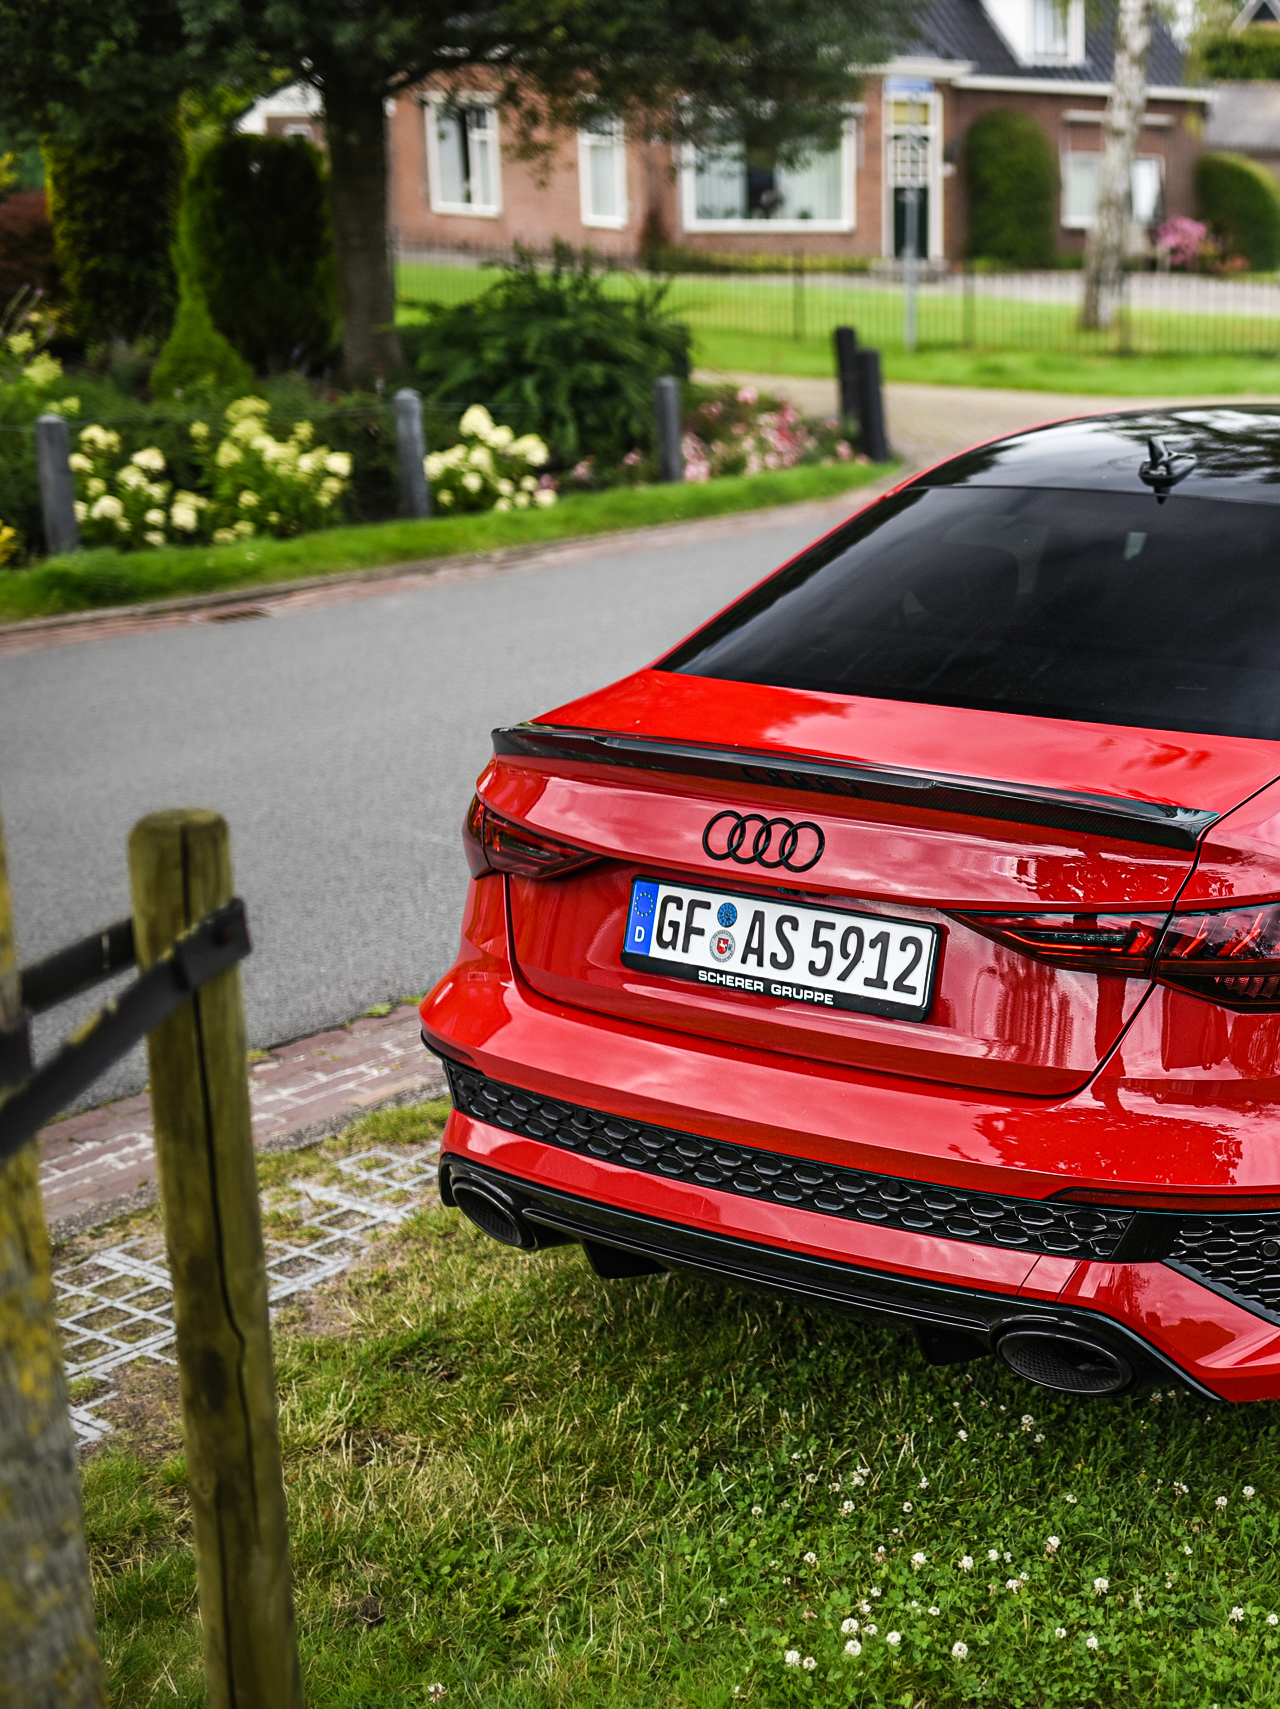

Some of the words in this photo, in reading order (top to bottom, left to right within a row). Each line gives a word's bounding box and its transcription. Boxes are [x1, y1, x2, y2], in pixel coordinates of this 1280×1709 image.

[634, 925, 645, 943] D
[656, 894, 712, 953] GF
[740, 910, 799, 970] AS
[808, 919, 923, 995] 5912
[698, 970, 764, 992] SCHERER
[770, 984, 834, 1006] GRUPPE
